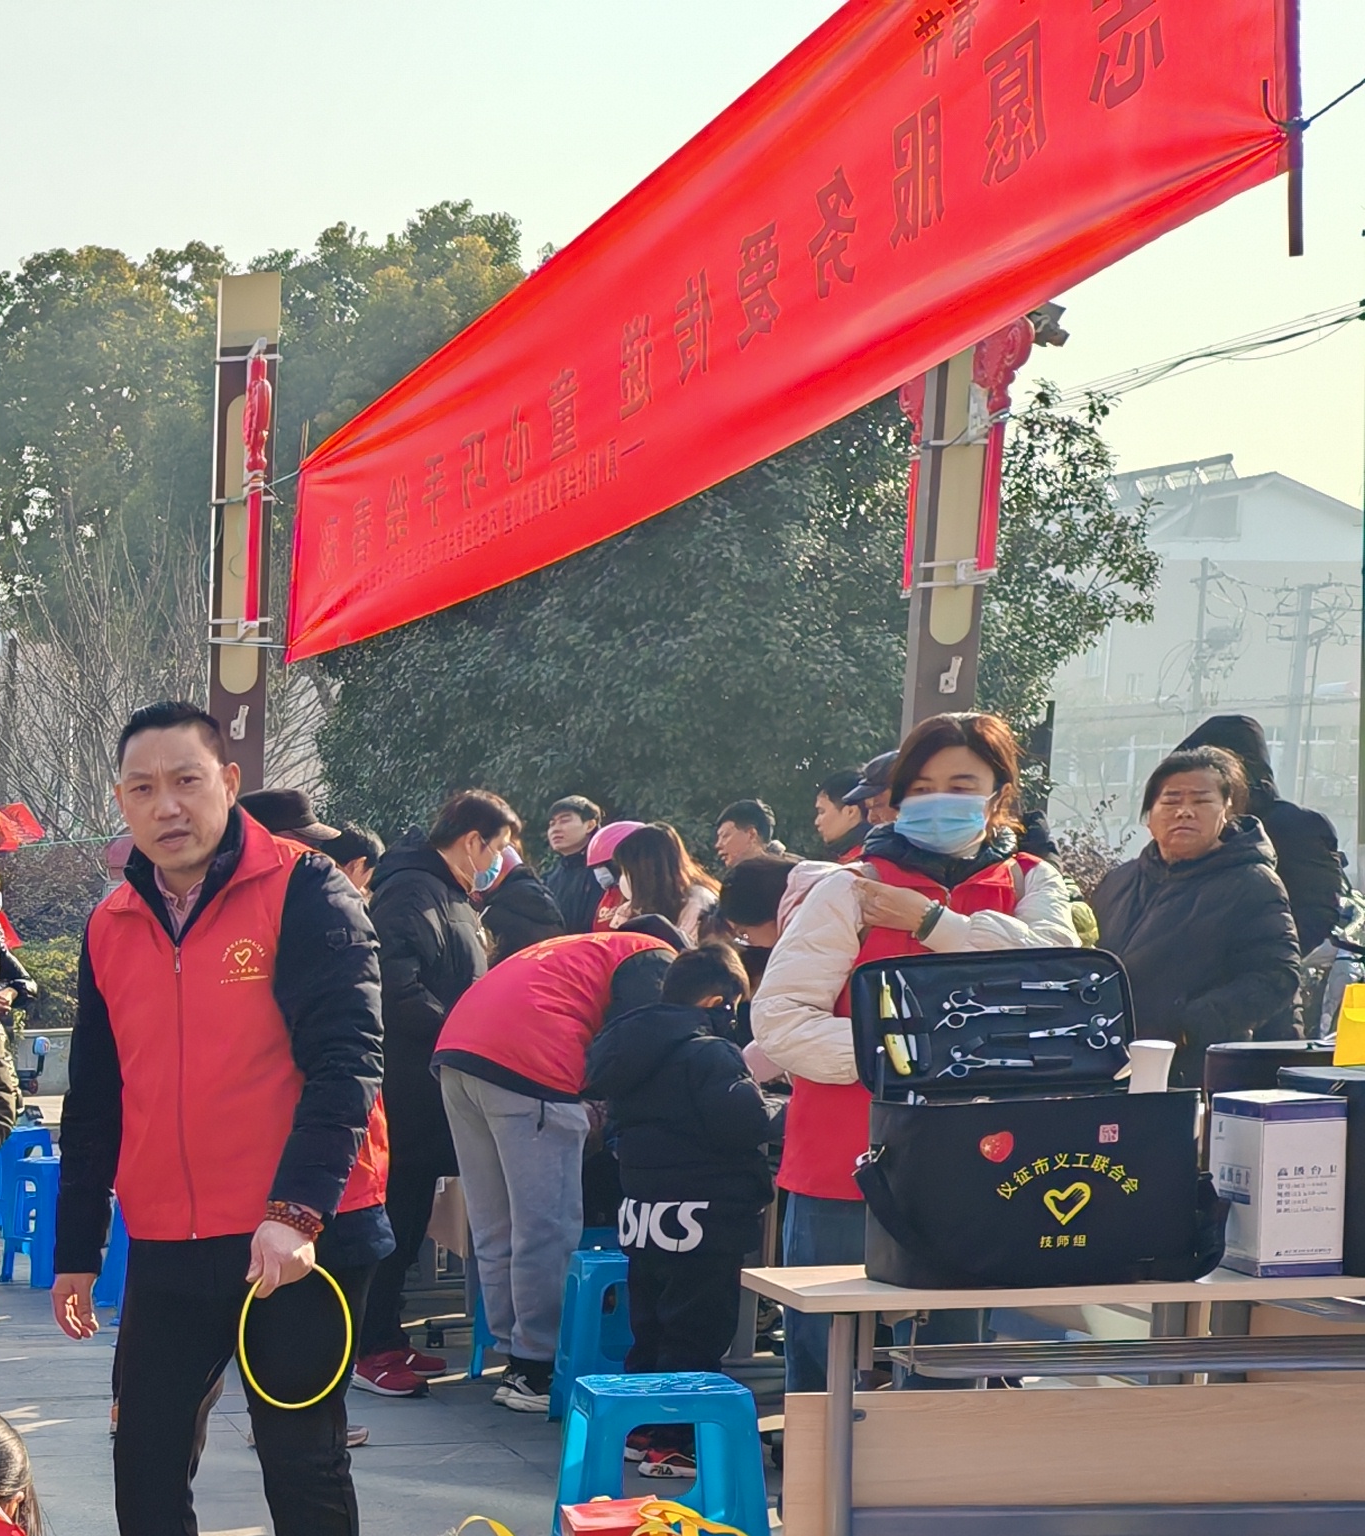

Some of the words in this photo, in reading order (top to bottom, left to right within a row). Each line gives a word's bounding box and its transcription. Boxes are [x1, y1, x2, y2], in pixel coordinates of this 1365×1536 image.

[996, 1152, 1141, 1201] 仪征市义工联合会
[1039, 1234, 1087, 1249] 技师组
